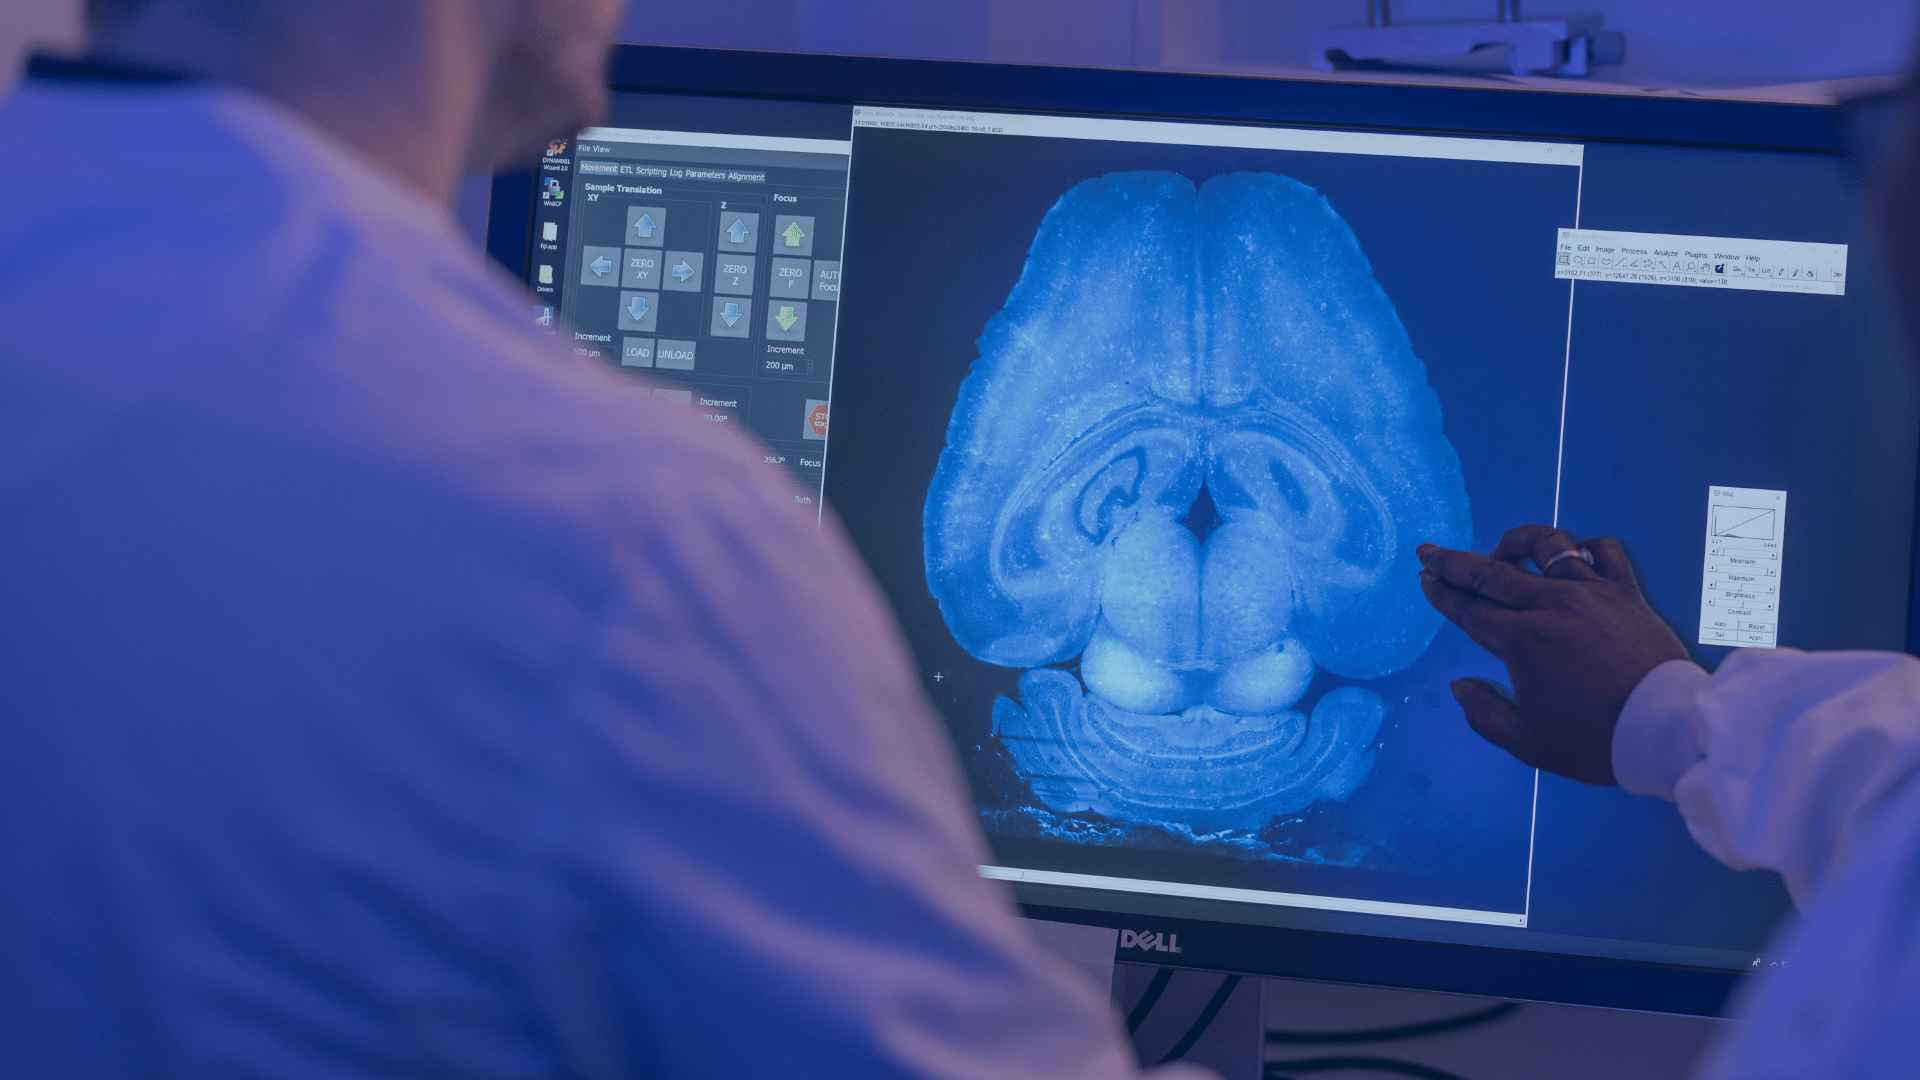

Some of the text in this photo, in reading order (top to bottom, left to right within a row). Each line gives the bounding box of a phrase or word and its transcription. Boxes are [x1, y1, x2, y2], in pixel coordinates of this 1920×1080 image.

[578, 144, 611, 153] File View
[542, 157, 571, 165] DYNAMIXEL
[581, 163, 765, 182] Movement ETL Scripting Log Parameters Alignment
[585, 182, 663, 195] Sample Translation
[587, 193, 600, 202] XY
[774, 194, 798, 202] Focus
[720, 201, 727, 209] Z
[1560, 243, 1761, 263] File Edit Image Process Analyze Plugins Window Help
[630, 258, 655, 269] ZERO
[723, 264, 748, 274] ZERO
[778, 267, 803, 278] ZERO
[636, 270, 649, 280] XY
[732, 276, 739, 286] Z
[788, 280, 795, 289] F
[536, 285, 554, 293] Drivers
[574, 331, 612, 342] Increment
[626, 347, 650, 357] LOAD
[657, 349, 694, 360] UNLOAD
[766, 344, 805, 355] Increment
[765, 360, 794, 371] 200 µm
[699, 397, 737, 408] Increment
[800, 458, 822, 467] Focus
[794, 495, 811, 504] Both
[1730, 557, 1756, 565] Minimum
[1728, 574, 1755, 582] Maximum
[1725, 591, 1756, 600] Brightness
[1727, 608, 1752, 616] Contrast
[1120, 928, 1182, 953] DELL
